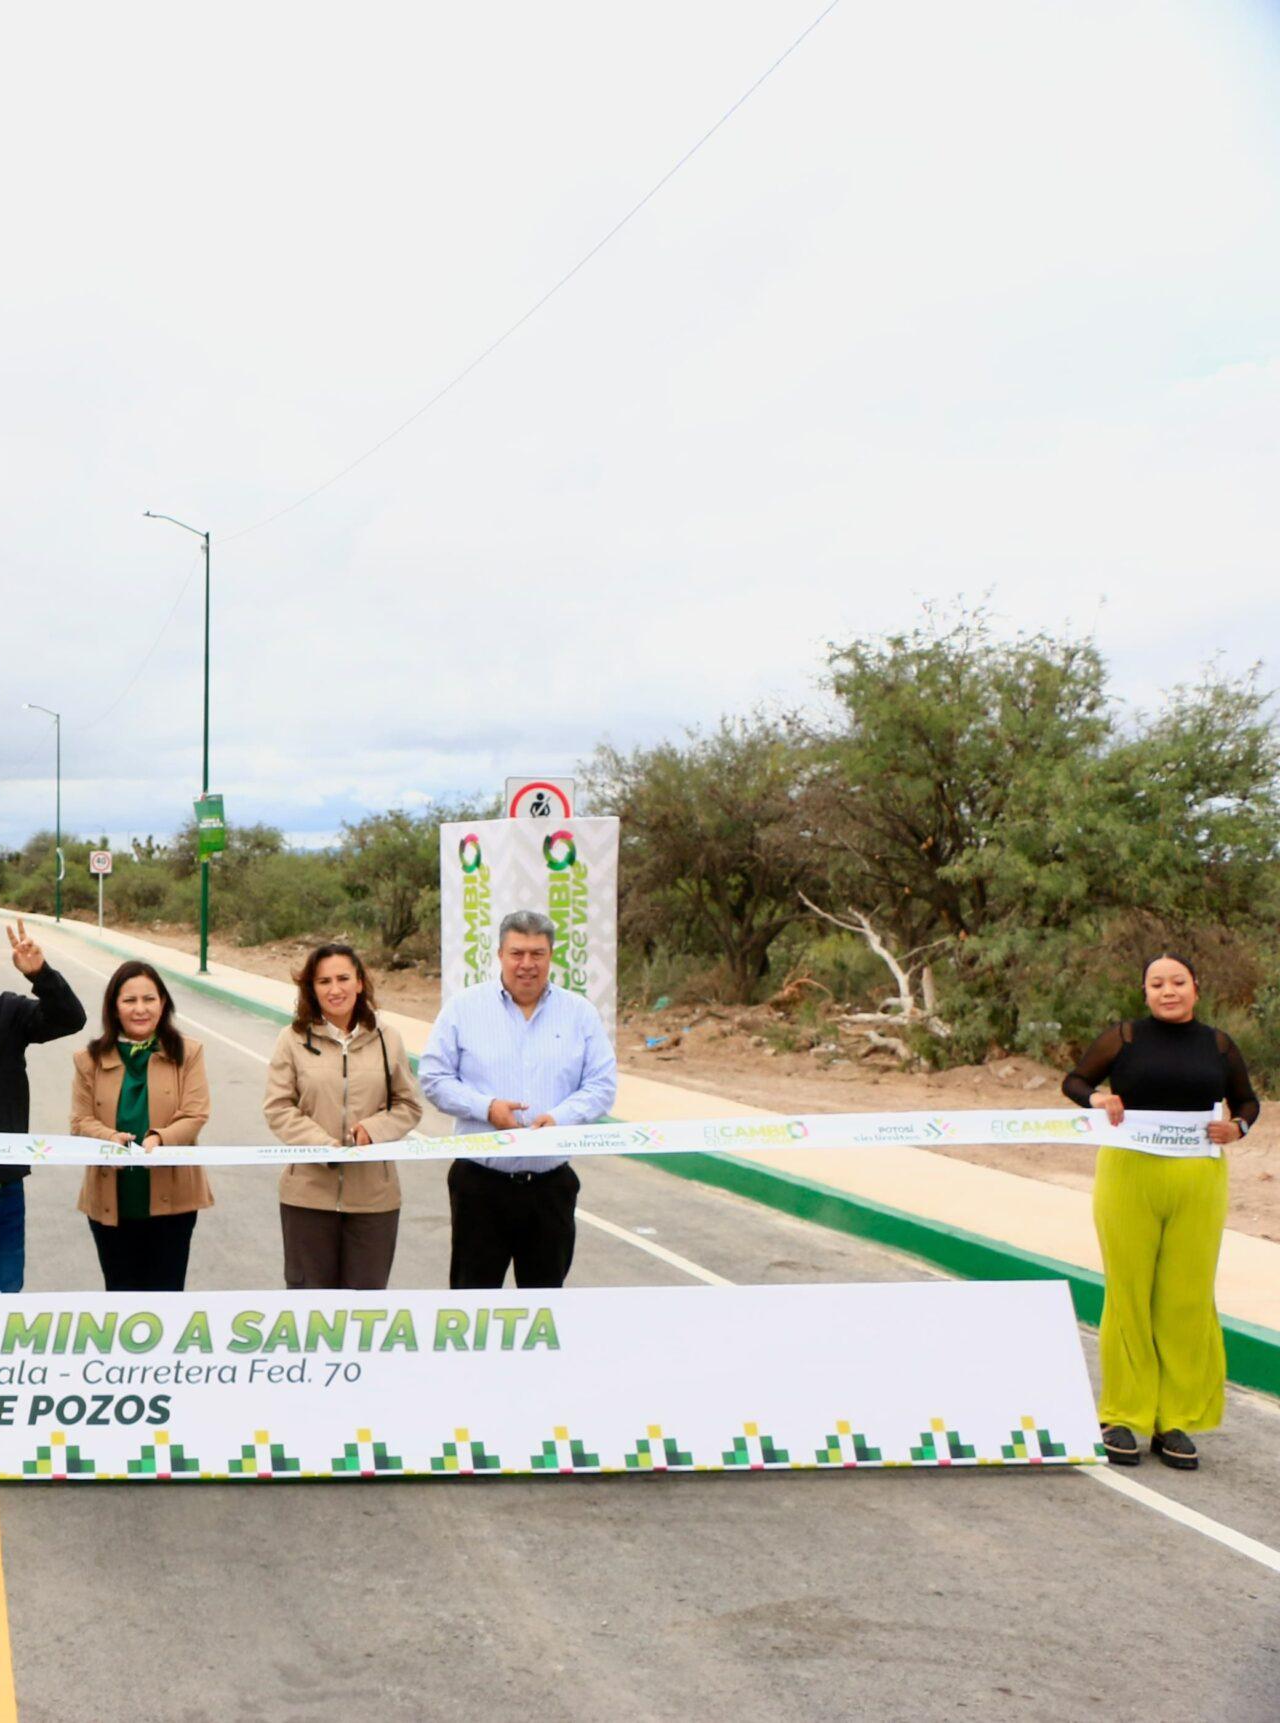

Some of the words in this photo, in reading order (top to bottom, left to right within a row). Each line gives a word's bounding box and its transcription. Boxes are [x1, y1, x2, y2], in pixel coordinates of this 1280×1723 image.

[477, 864, 491, 926] vive
[569, 860, 589, 926] vive
[480, 932, 492, 964] se
[571, 932, 589, 964] se
[172, 1310, 213, 1354] A
[226, 1308, 419, 1353] SANTA
[433, 1307, 561, 1352] RITA
[82, 1359, 237, 1385] Carretera
[248, 1357, 313, 1384] Fed.
[324, 1362, 362, 1388] 70
[27, 1393, 172, 1426] POZOS
